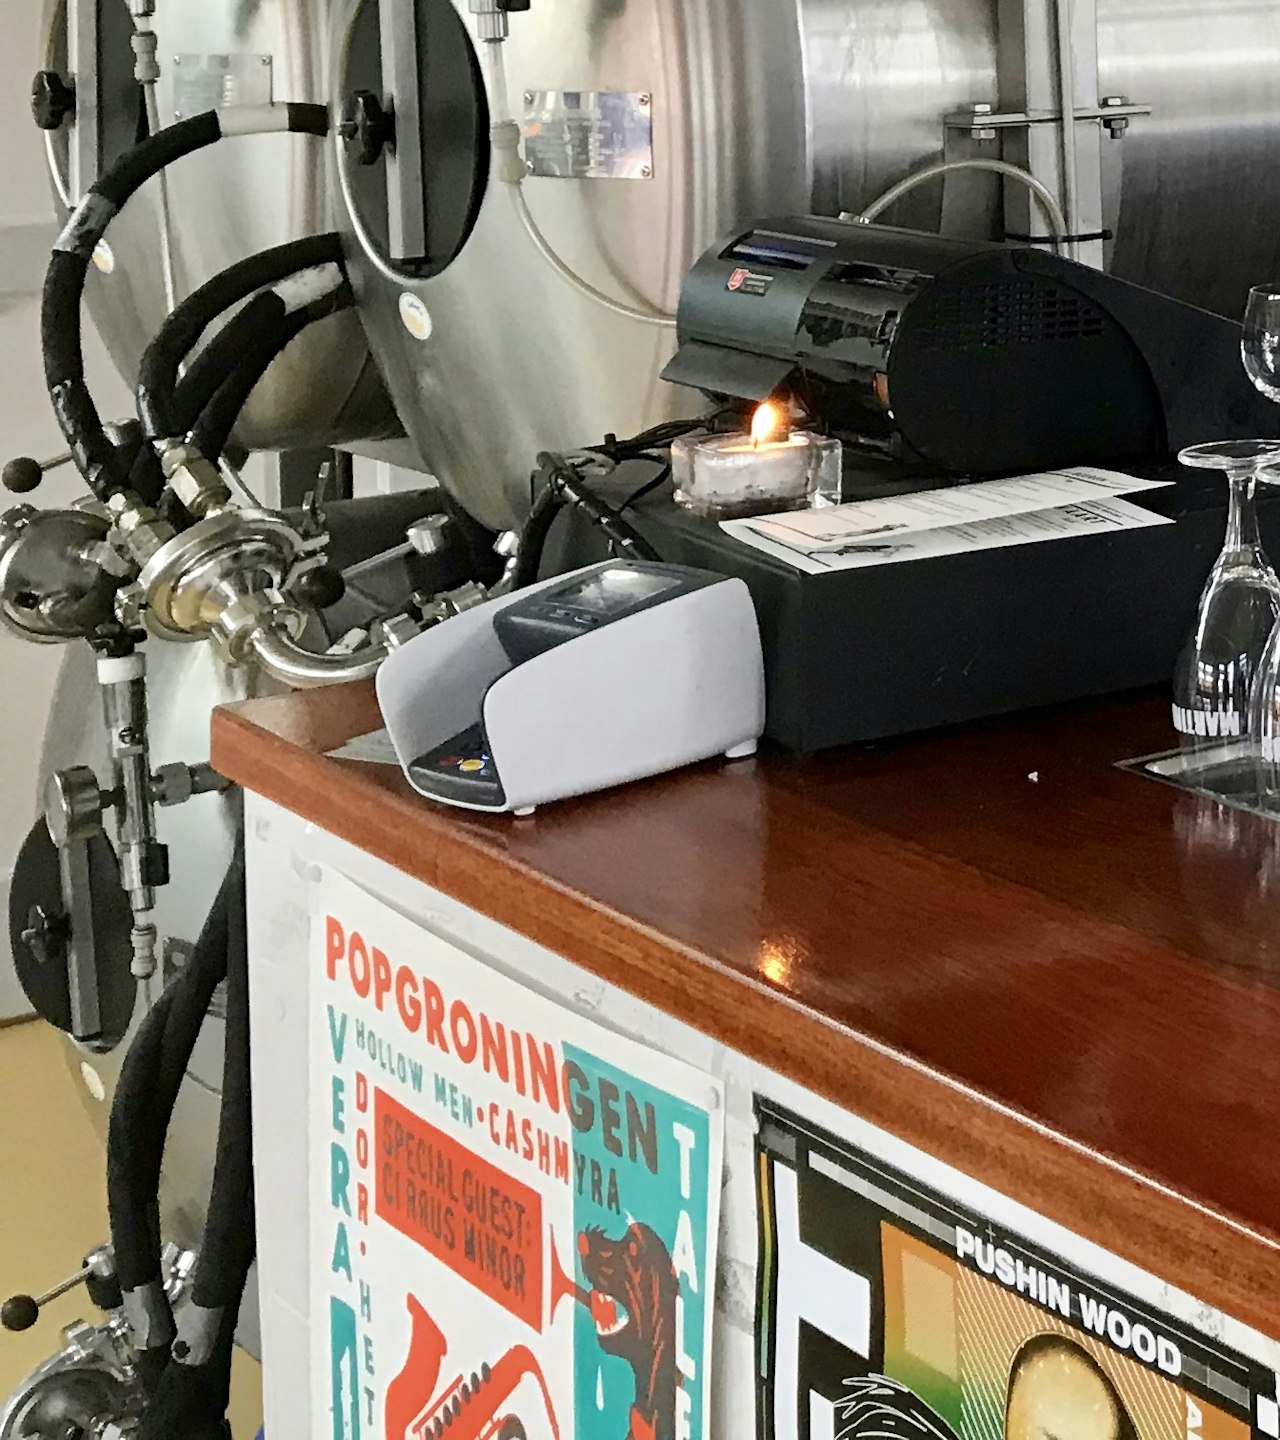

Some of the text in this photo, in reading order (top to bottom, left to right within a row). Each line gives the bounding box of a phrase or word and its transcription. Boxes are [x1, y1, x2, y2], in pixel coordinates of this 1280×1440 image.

[327, 916, 659, 1175] POPGRONINGEN
[355, 1017, 621, 1217] HOLLOW MEN CASHMYRA
[327, 1005, 352, 1283] VERA
[382, 1113, 458, 1205] SPECIAL
[382, 1166, 526, 1303] CIRRUS MINOR
[955, 1225, 1183, 1378] PUSHIN WOOD
